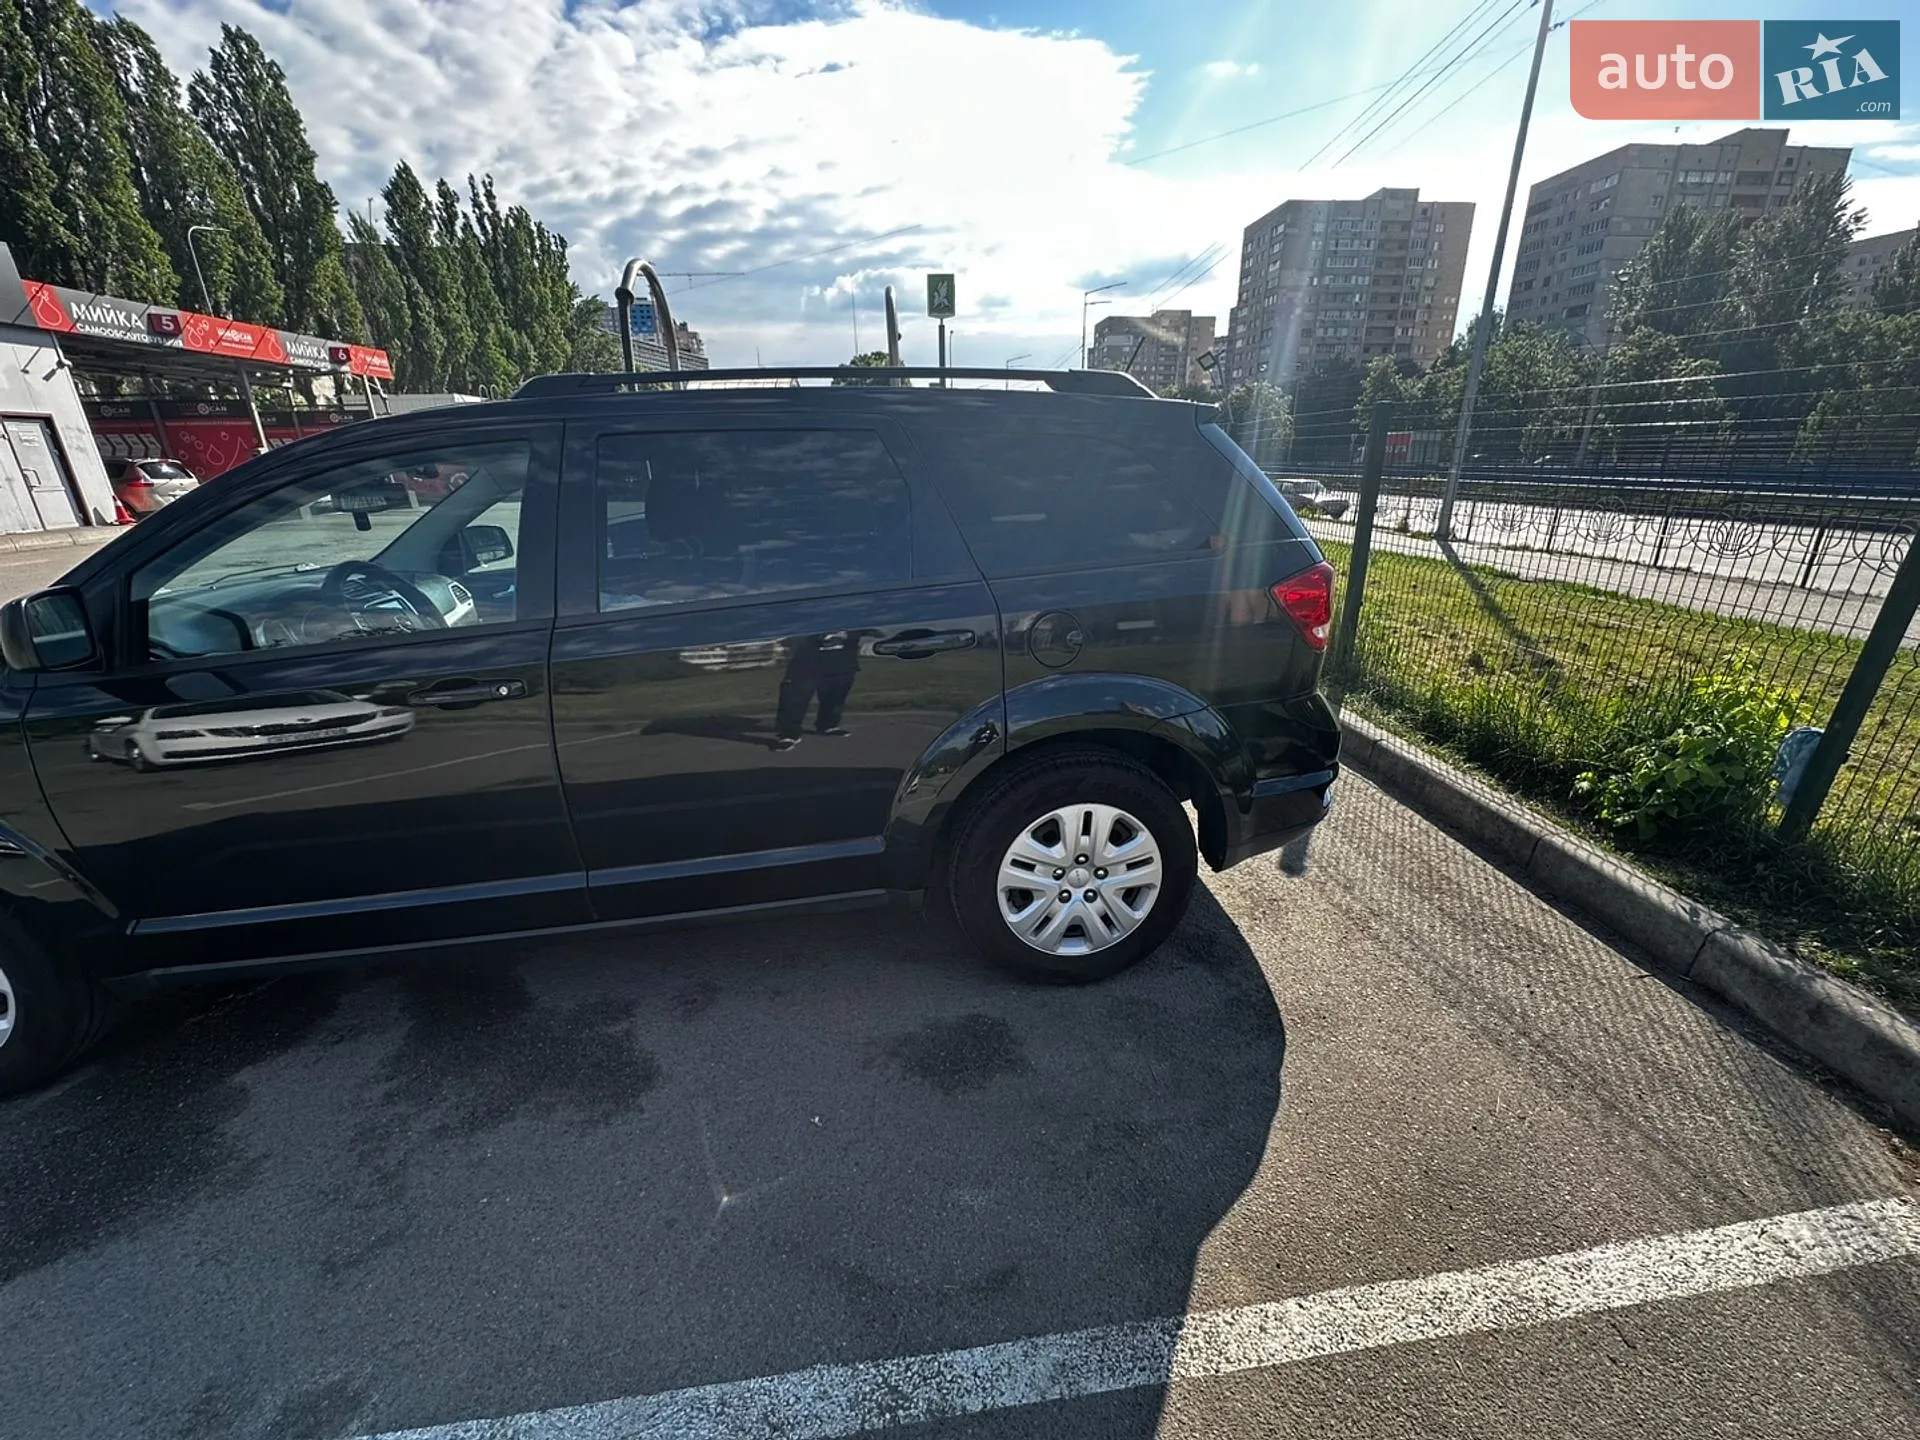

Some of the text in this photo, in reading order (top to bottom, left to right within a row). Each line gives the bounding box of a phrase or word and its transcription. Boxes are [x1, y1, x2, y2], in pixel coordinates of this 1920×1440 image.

[70, 301, 145, 330] МИЙКА
[161, 316, 175, 331] 5
[285, 341, 329, 360] МИЙКА
[338, 348, 347, 360] 6
